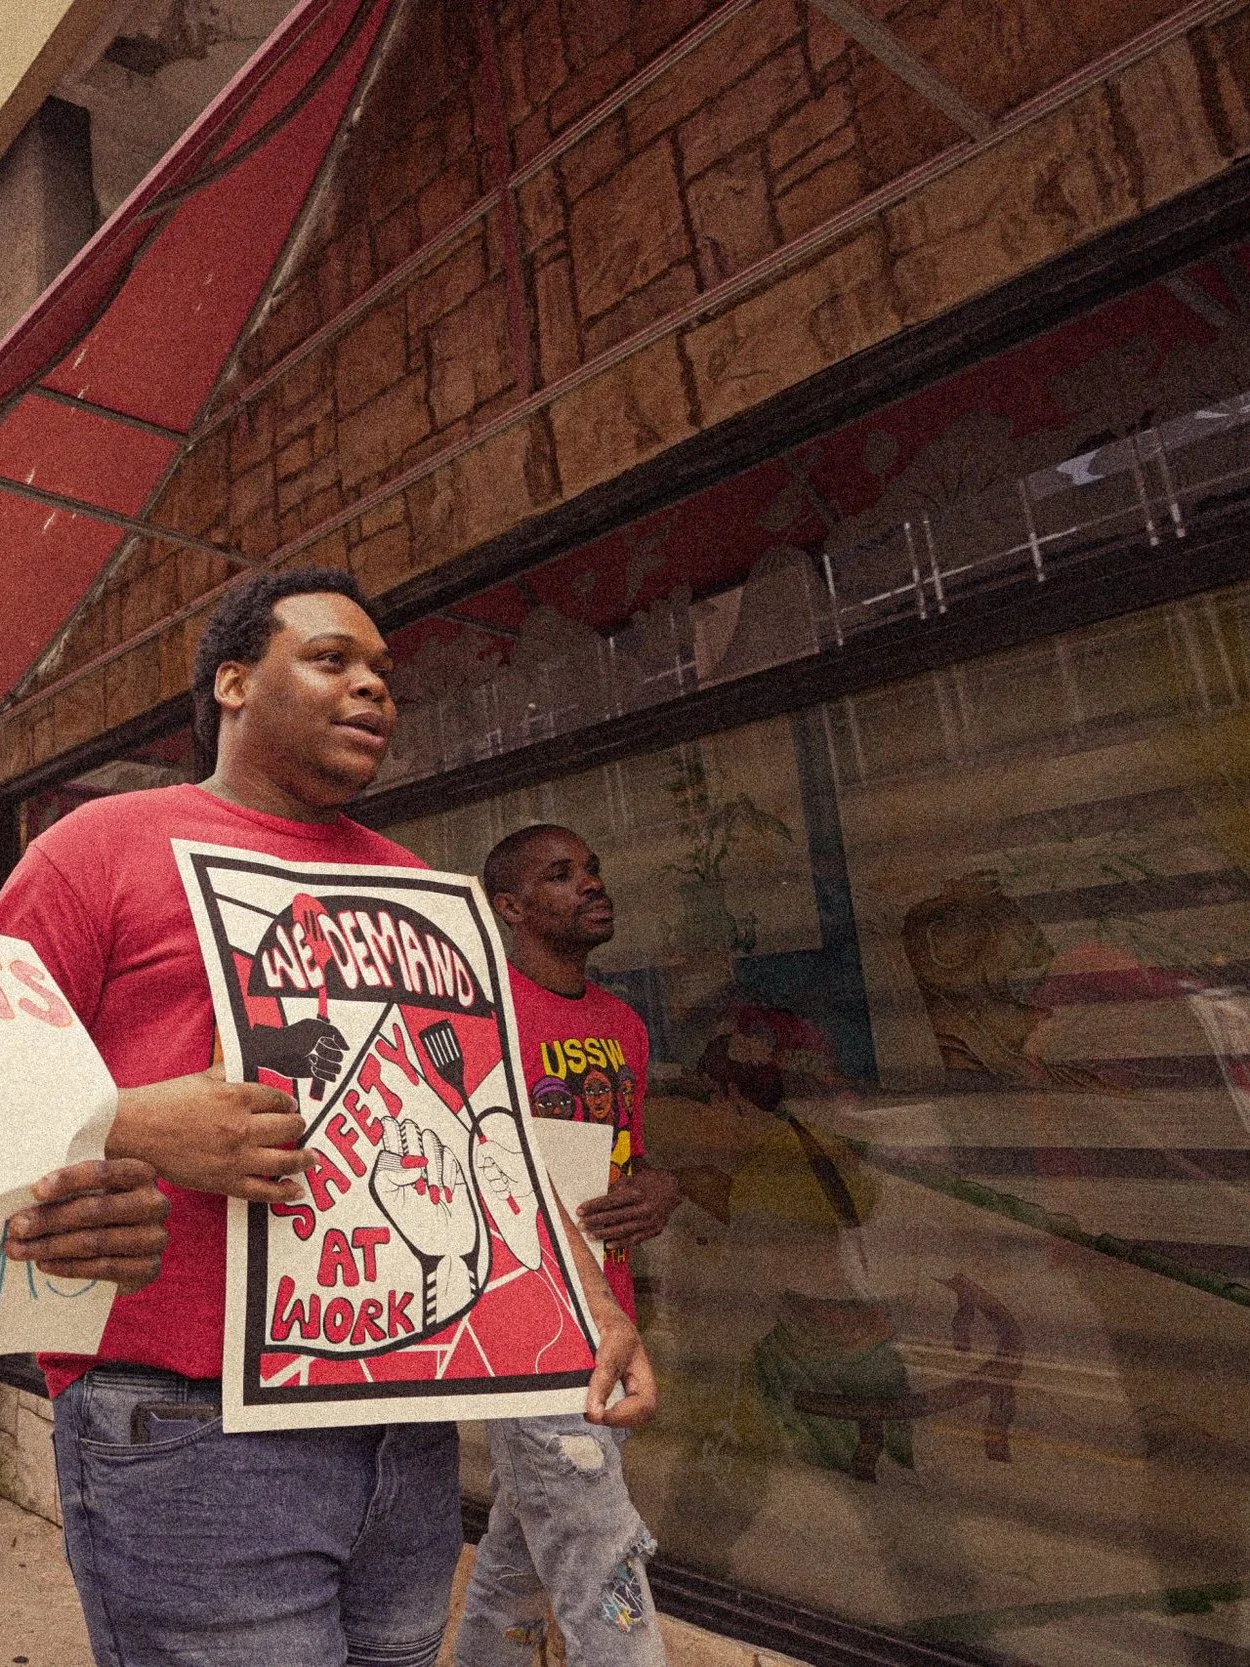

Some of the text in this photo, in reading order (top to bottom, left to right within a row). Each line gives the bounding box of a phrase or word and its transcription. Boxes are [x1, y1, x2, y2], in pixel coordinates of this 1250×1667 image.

[261, 909, 474, 1007] WE DEMAND
[540, 1037, 626, 1080] USSW
[269, 1022, 421, 1241] SAFETY
[316, 1226, 391, 1287] AT
[269, 1274, 416, 1345] WORK
